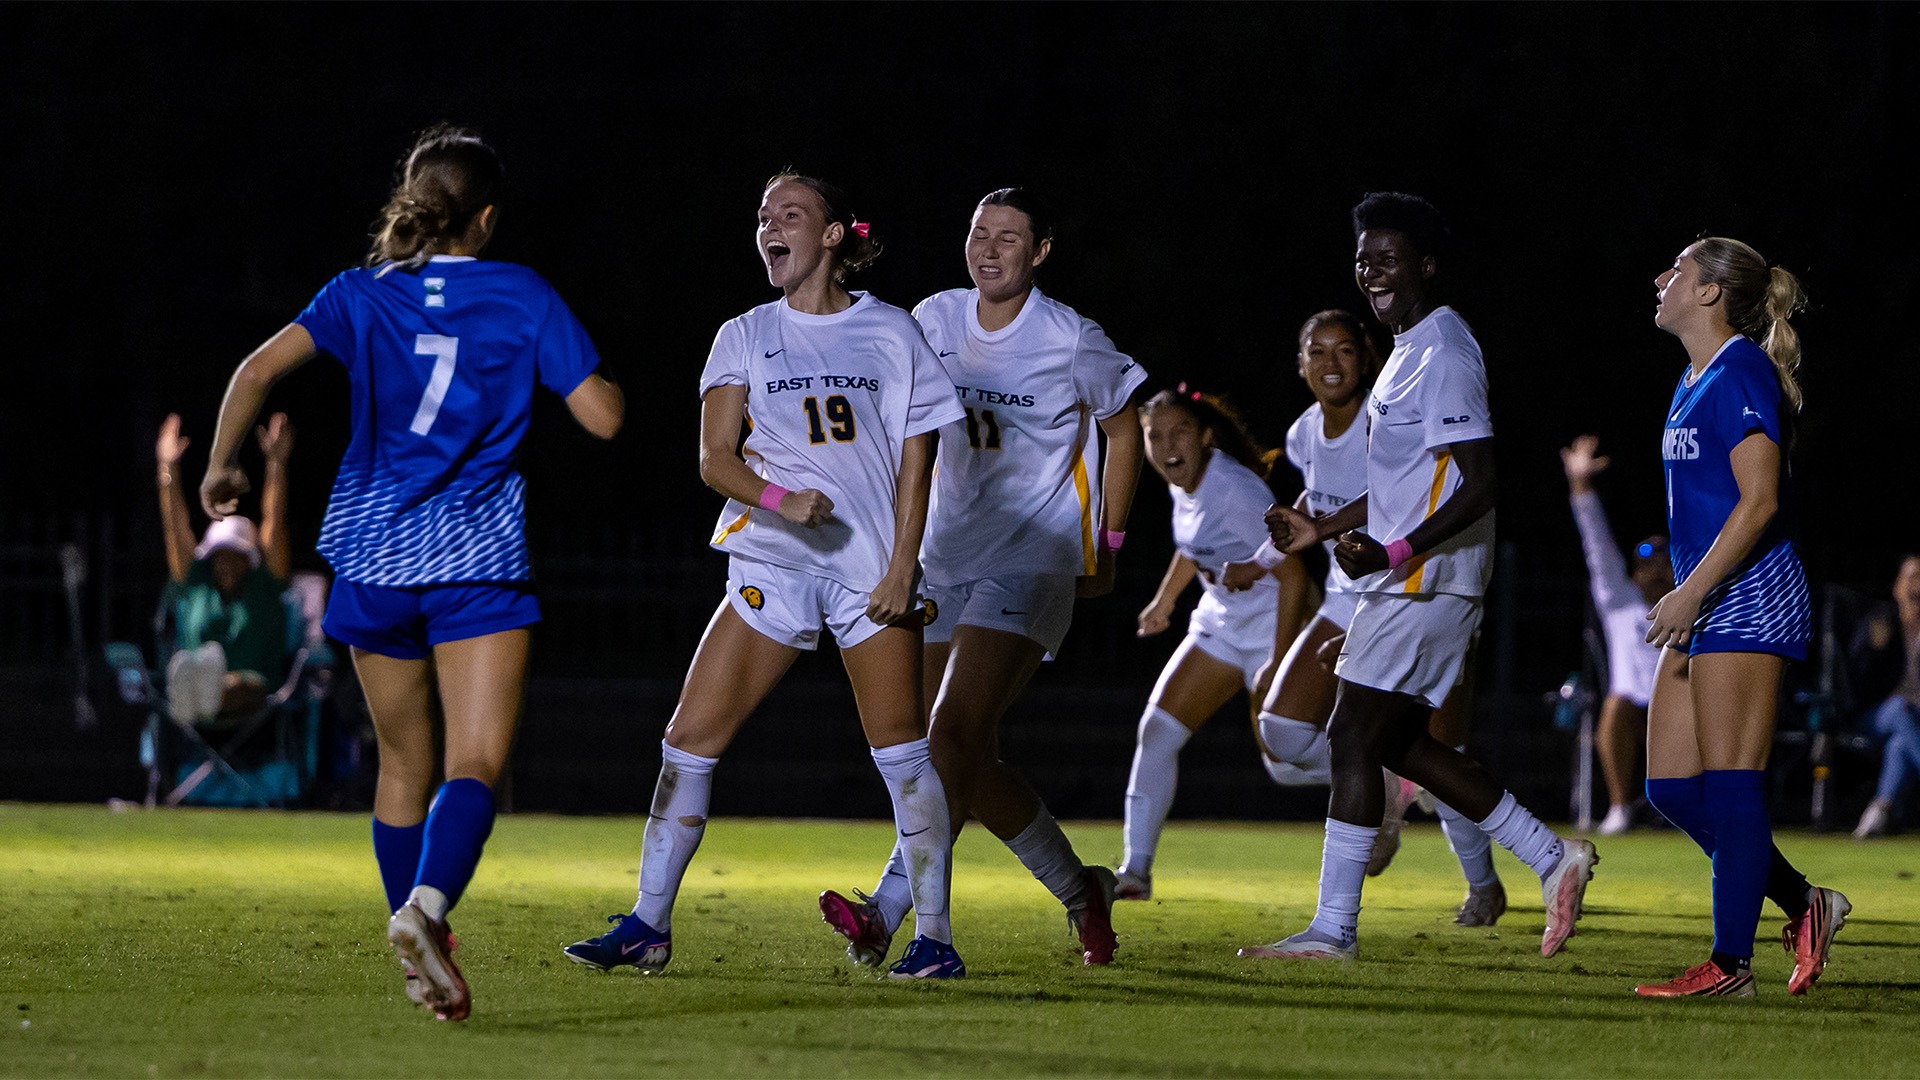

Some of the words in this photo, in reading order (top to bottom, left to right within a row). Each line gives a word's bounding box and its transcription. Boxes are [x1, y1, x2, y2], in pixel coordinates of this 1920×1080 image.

[410, 334, 459, 437] 7
[766, 377, 814, 394] EAST
[820, 375, 879, 392] TEXAS
[976, 388, 1035, 407] TEXAS
[803, 394, 857, 446] 19
[964, 406, 1001, 451] 11
